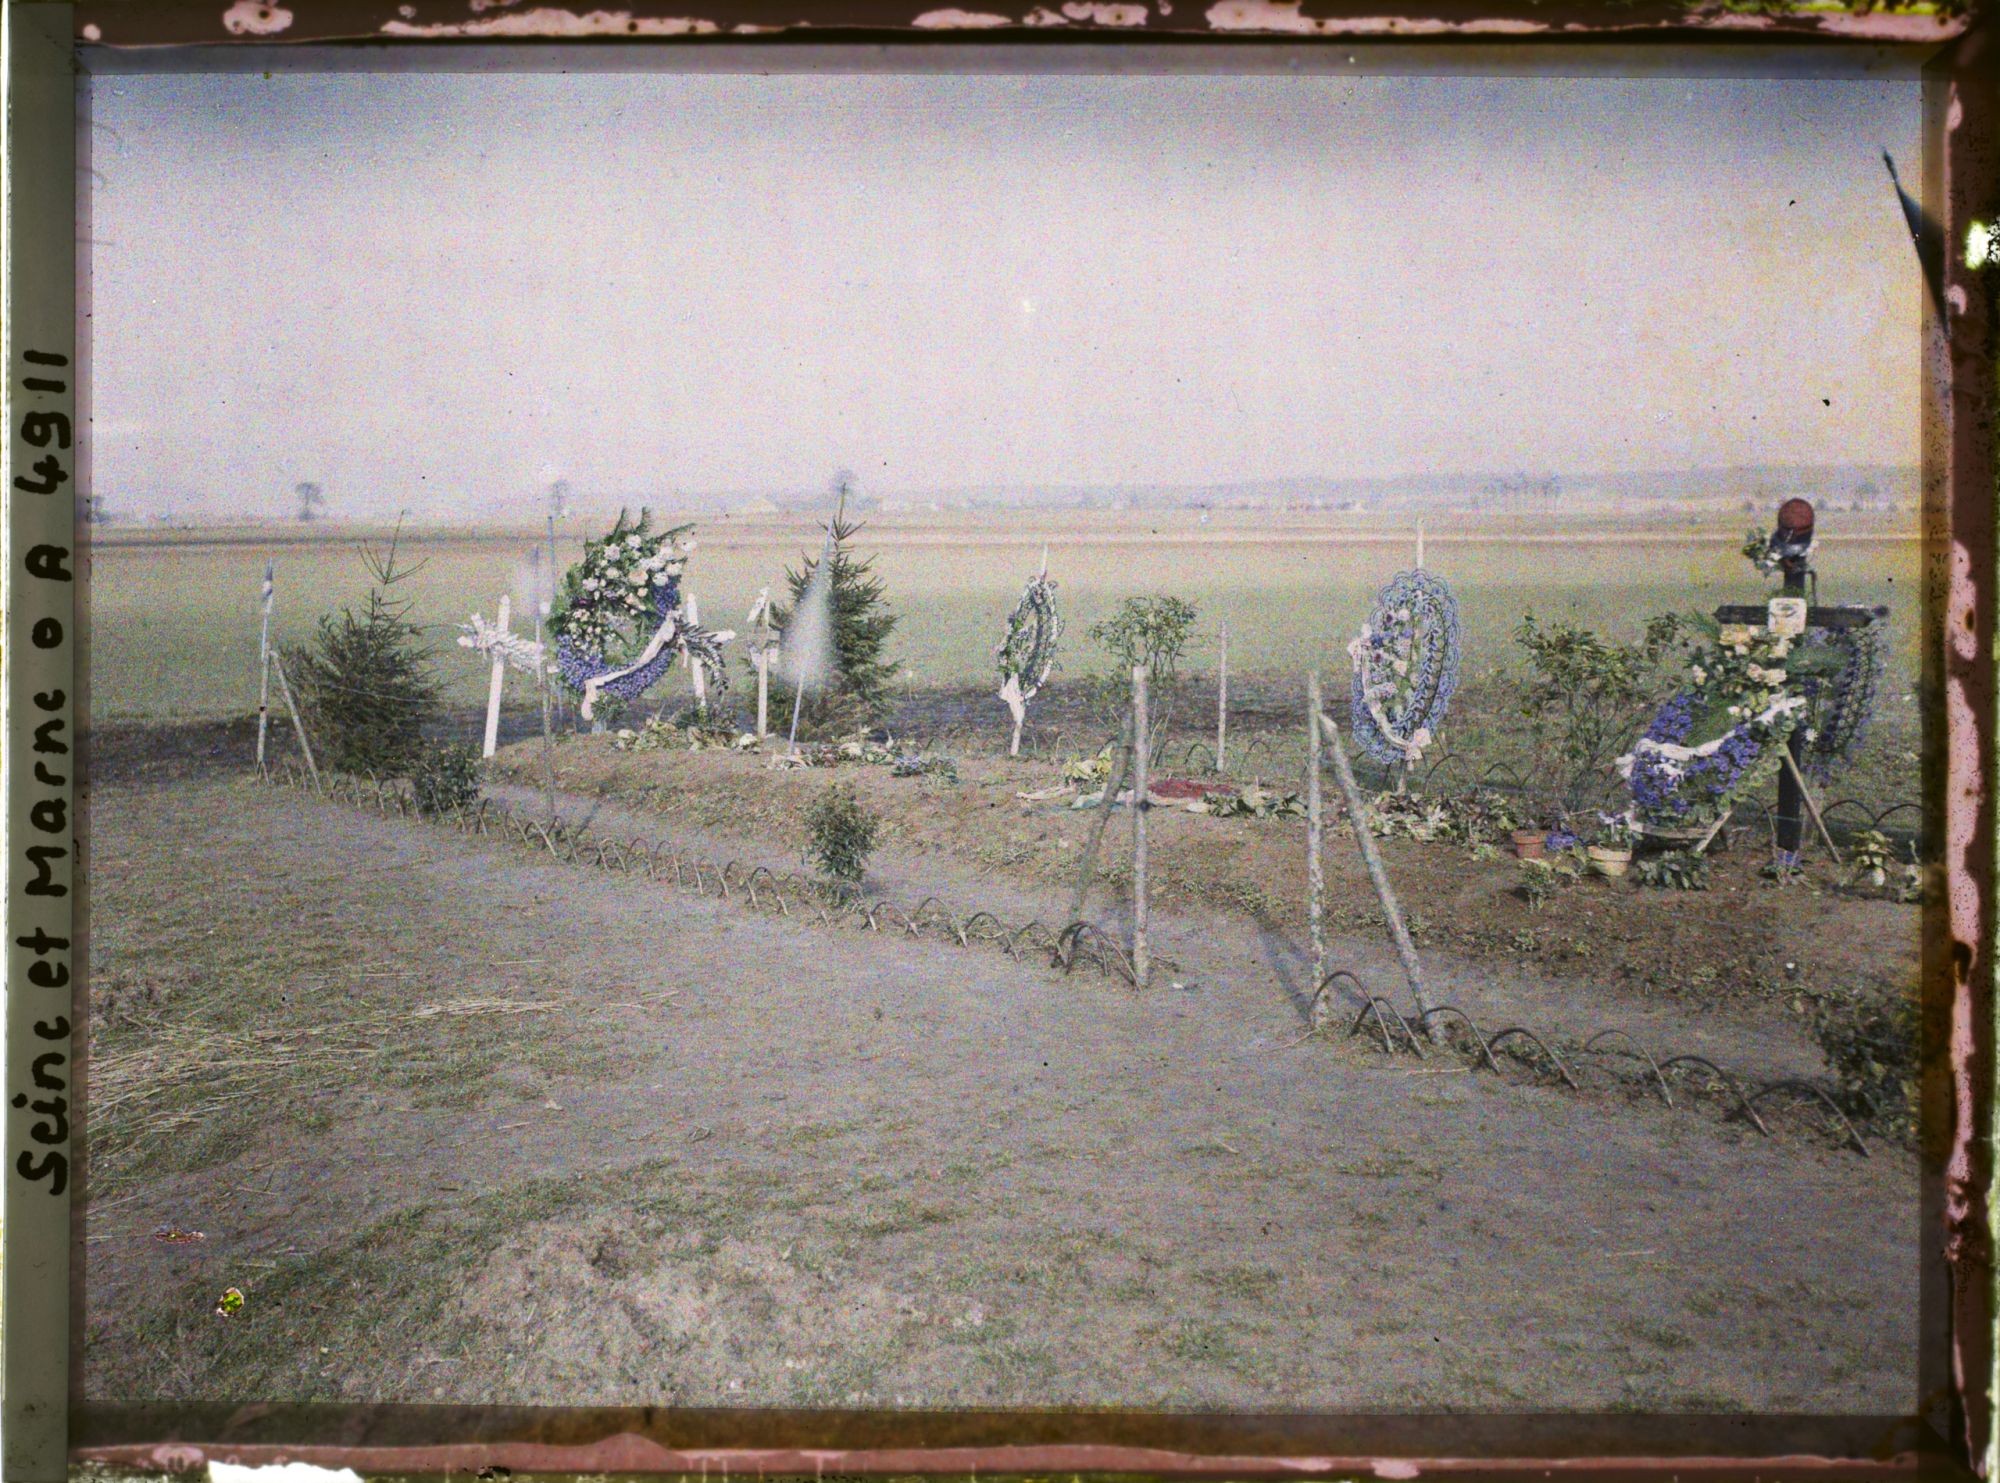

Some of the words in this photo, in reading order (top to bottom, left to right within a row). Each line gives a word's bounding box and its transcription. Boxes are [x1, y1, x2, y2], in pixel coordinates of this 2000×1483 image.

[14, 350, 71, 495] 4911
[25, 544, 72, 582] A
[25, 689, 69, 897] Marne
[16, 927, 70, 988] et
[12, 1015, 71, 1196] Seine
